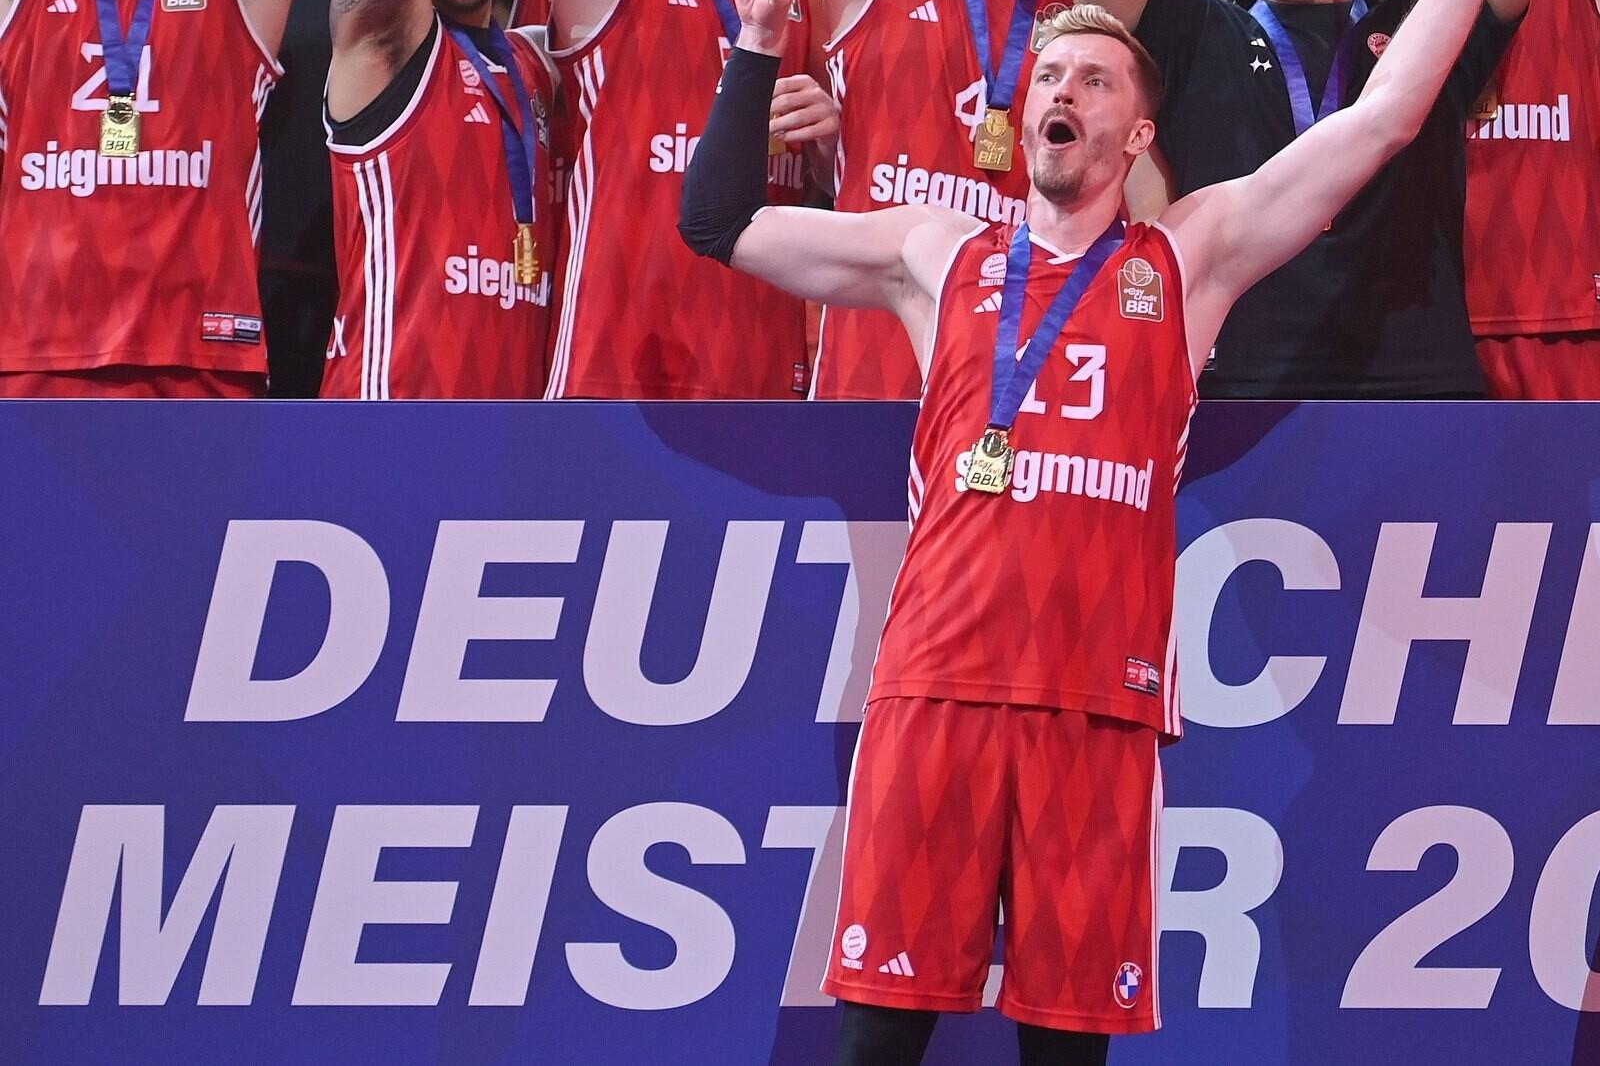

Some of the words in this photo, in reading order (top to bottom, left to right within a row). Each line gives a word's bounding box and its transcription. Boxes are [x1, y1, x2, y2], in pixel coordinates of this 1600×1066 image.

[71, 41, 160, 113] 21
[21, 140, 213, 199] siegmund
[104, 140, 134, 152] BBL
[870, 154, 1027, 226] siegmun
[1125, 299, 1158, 316] BBL
[954, 448, 1154, 512] sgmund
[970, 471, 999, 488] BBL
[38, 801, 1285, 1011] MEISTR
